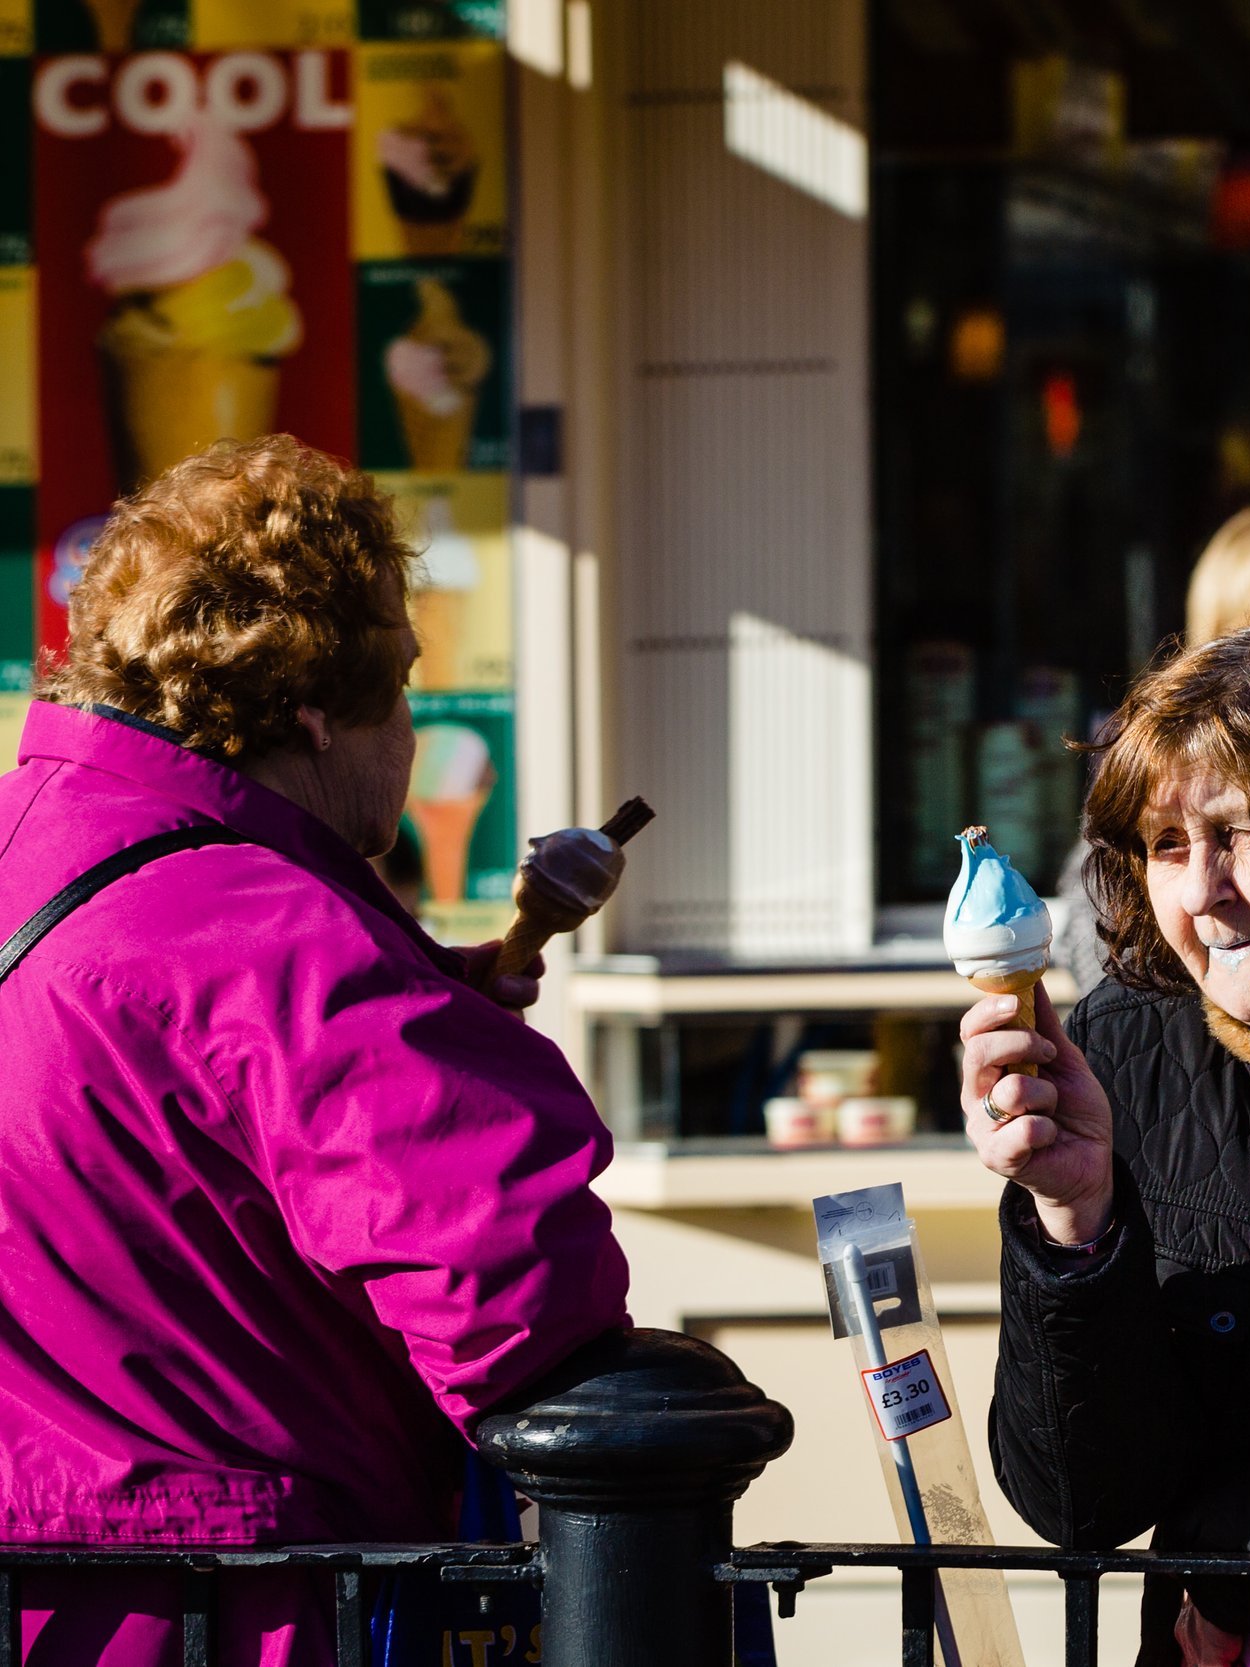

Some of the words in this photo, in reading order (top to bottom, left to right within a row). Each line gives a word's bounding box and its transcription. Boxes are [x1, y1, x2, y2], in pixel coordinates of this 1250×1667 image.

[34, 50, 353, 138] COOL
[873, 1357, 921, 1381] BOYES
[882, 1379, 930, 1409] £3.30
